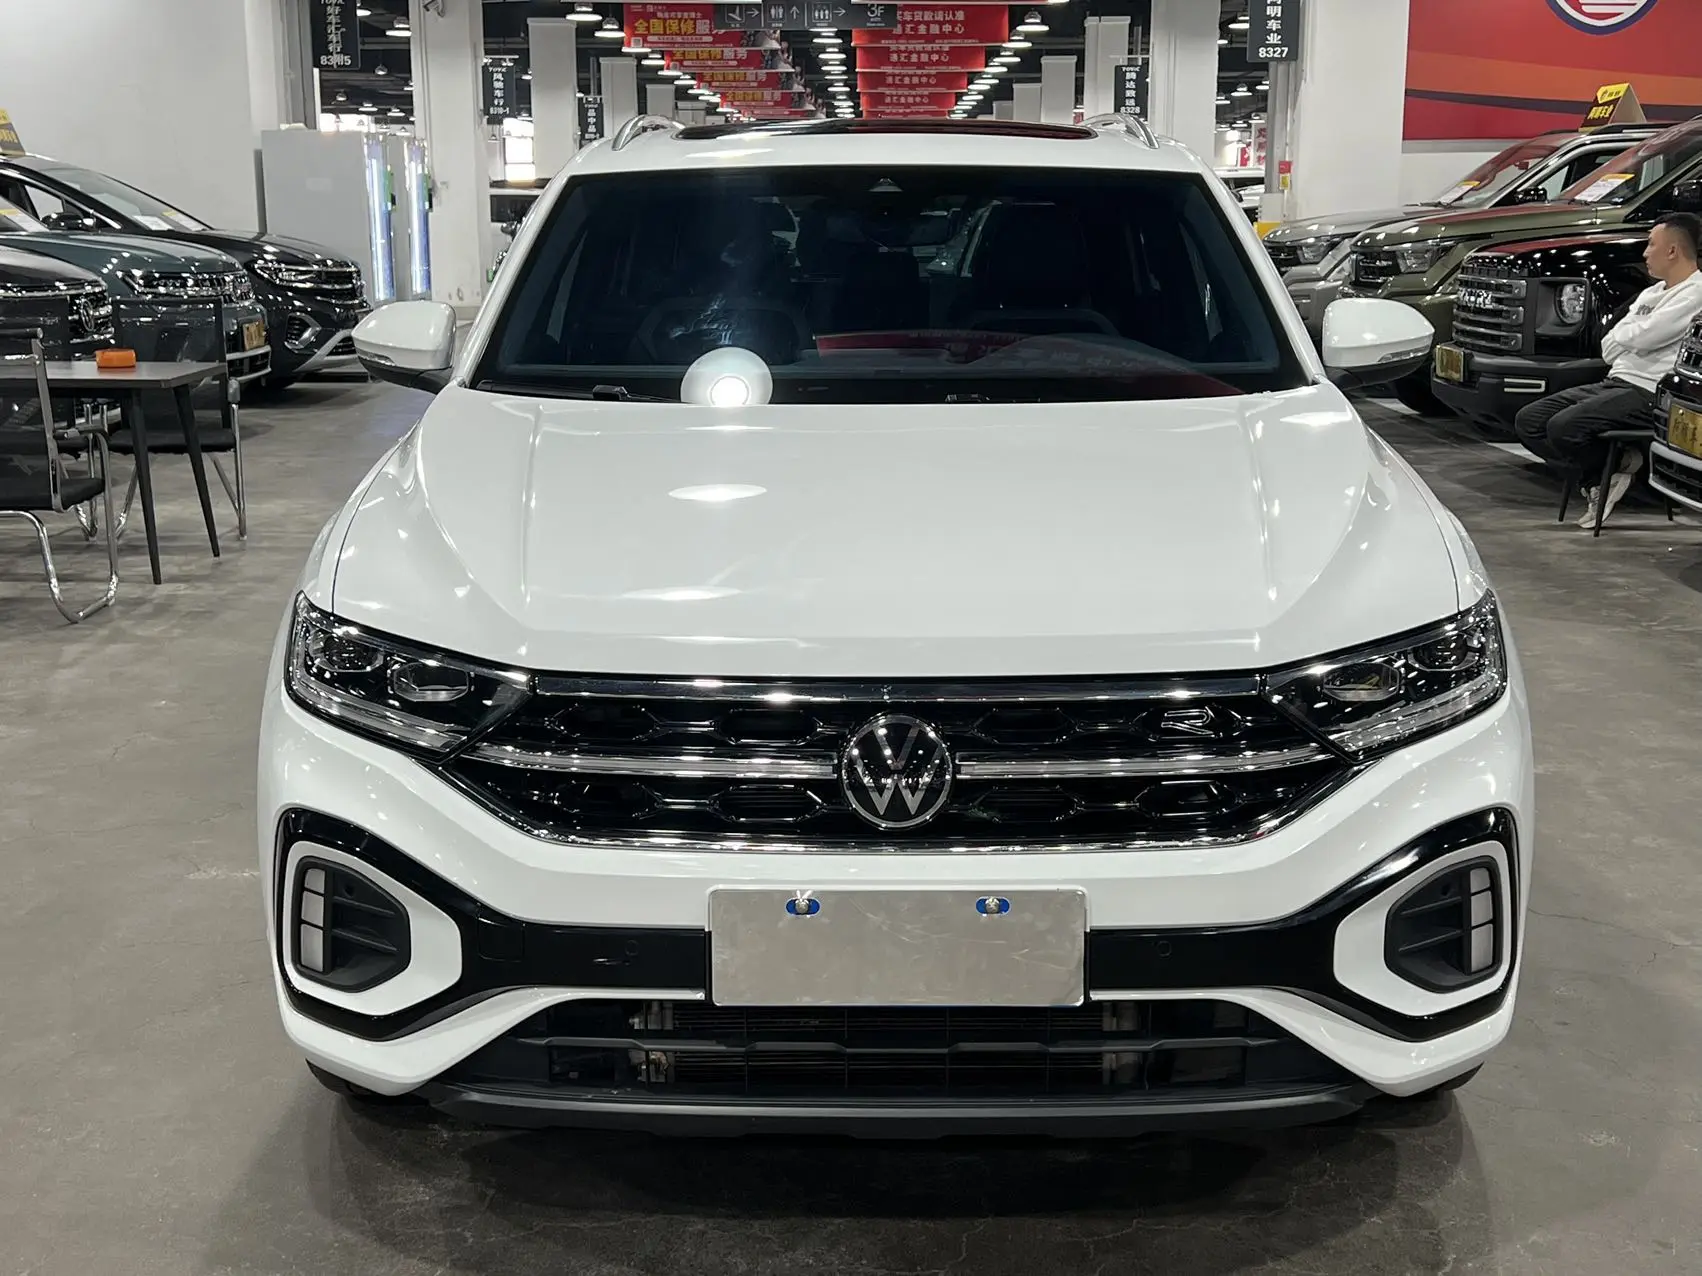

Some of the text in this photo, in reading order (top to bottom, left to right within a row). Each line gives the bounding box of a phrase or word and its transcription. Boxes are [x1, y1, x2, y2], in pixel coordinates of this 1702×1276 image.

[867, 3, 885, 17] 3F
[634, 19, 726, 35] 全国保修服
[1258, 46, 1289, 58] 8327
